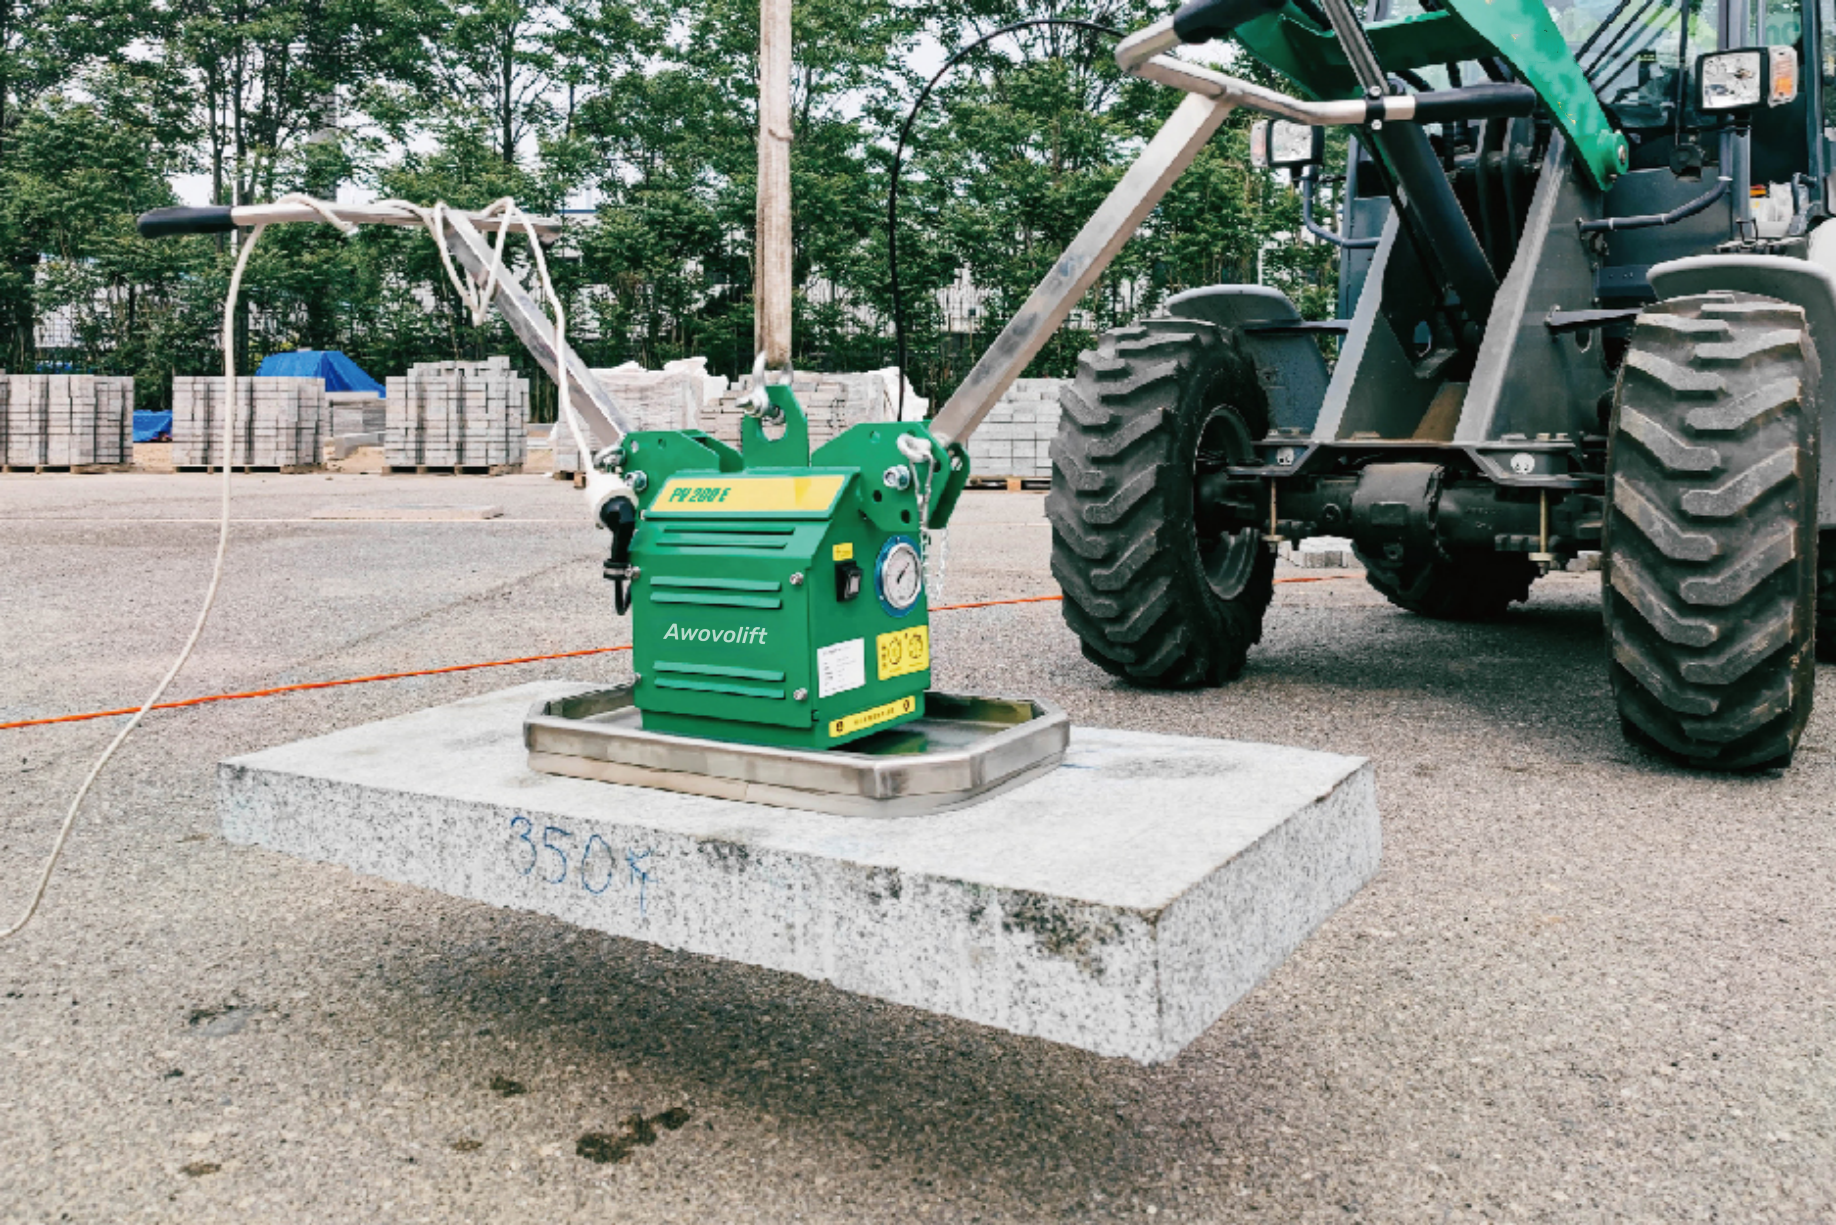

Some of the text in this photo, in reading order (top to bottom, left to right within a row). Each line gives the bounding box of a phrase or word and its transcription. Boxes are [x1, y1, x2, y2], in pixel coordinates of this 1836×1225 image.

[687, 487, 722, 503] 200
[717, 487, 732, 503] E
[662, 623, 768, 645] Awovolift
